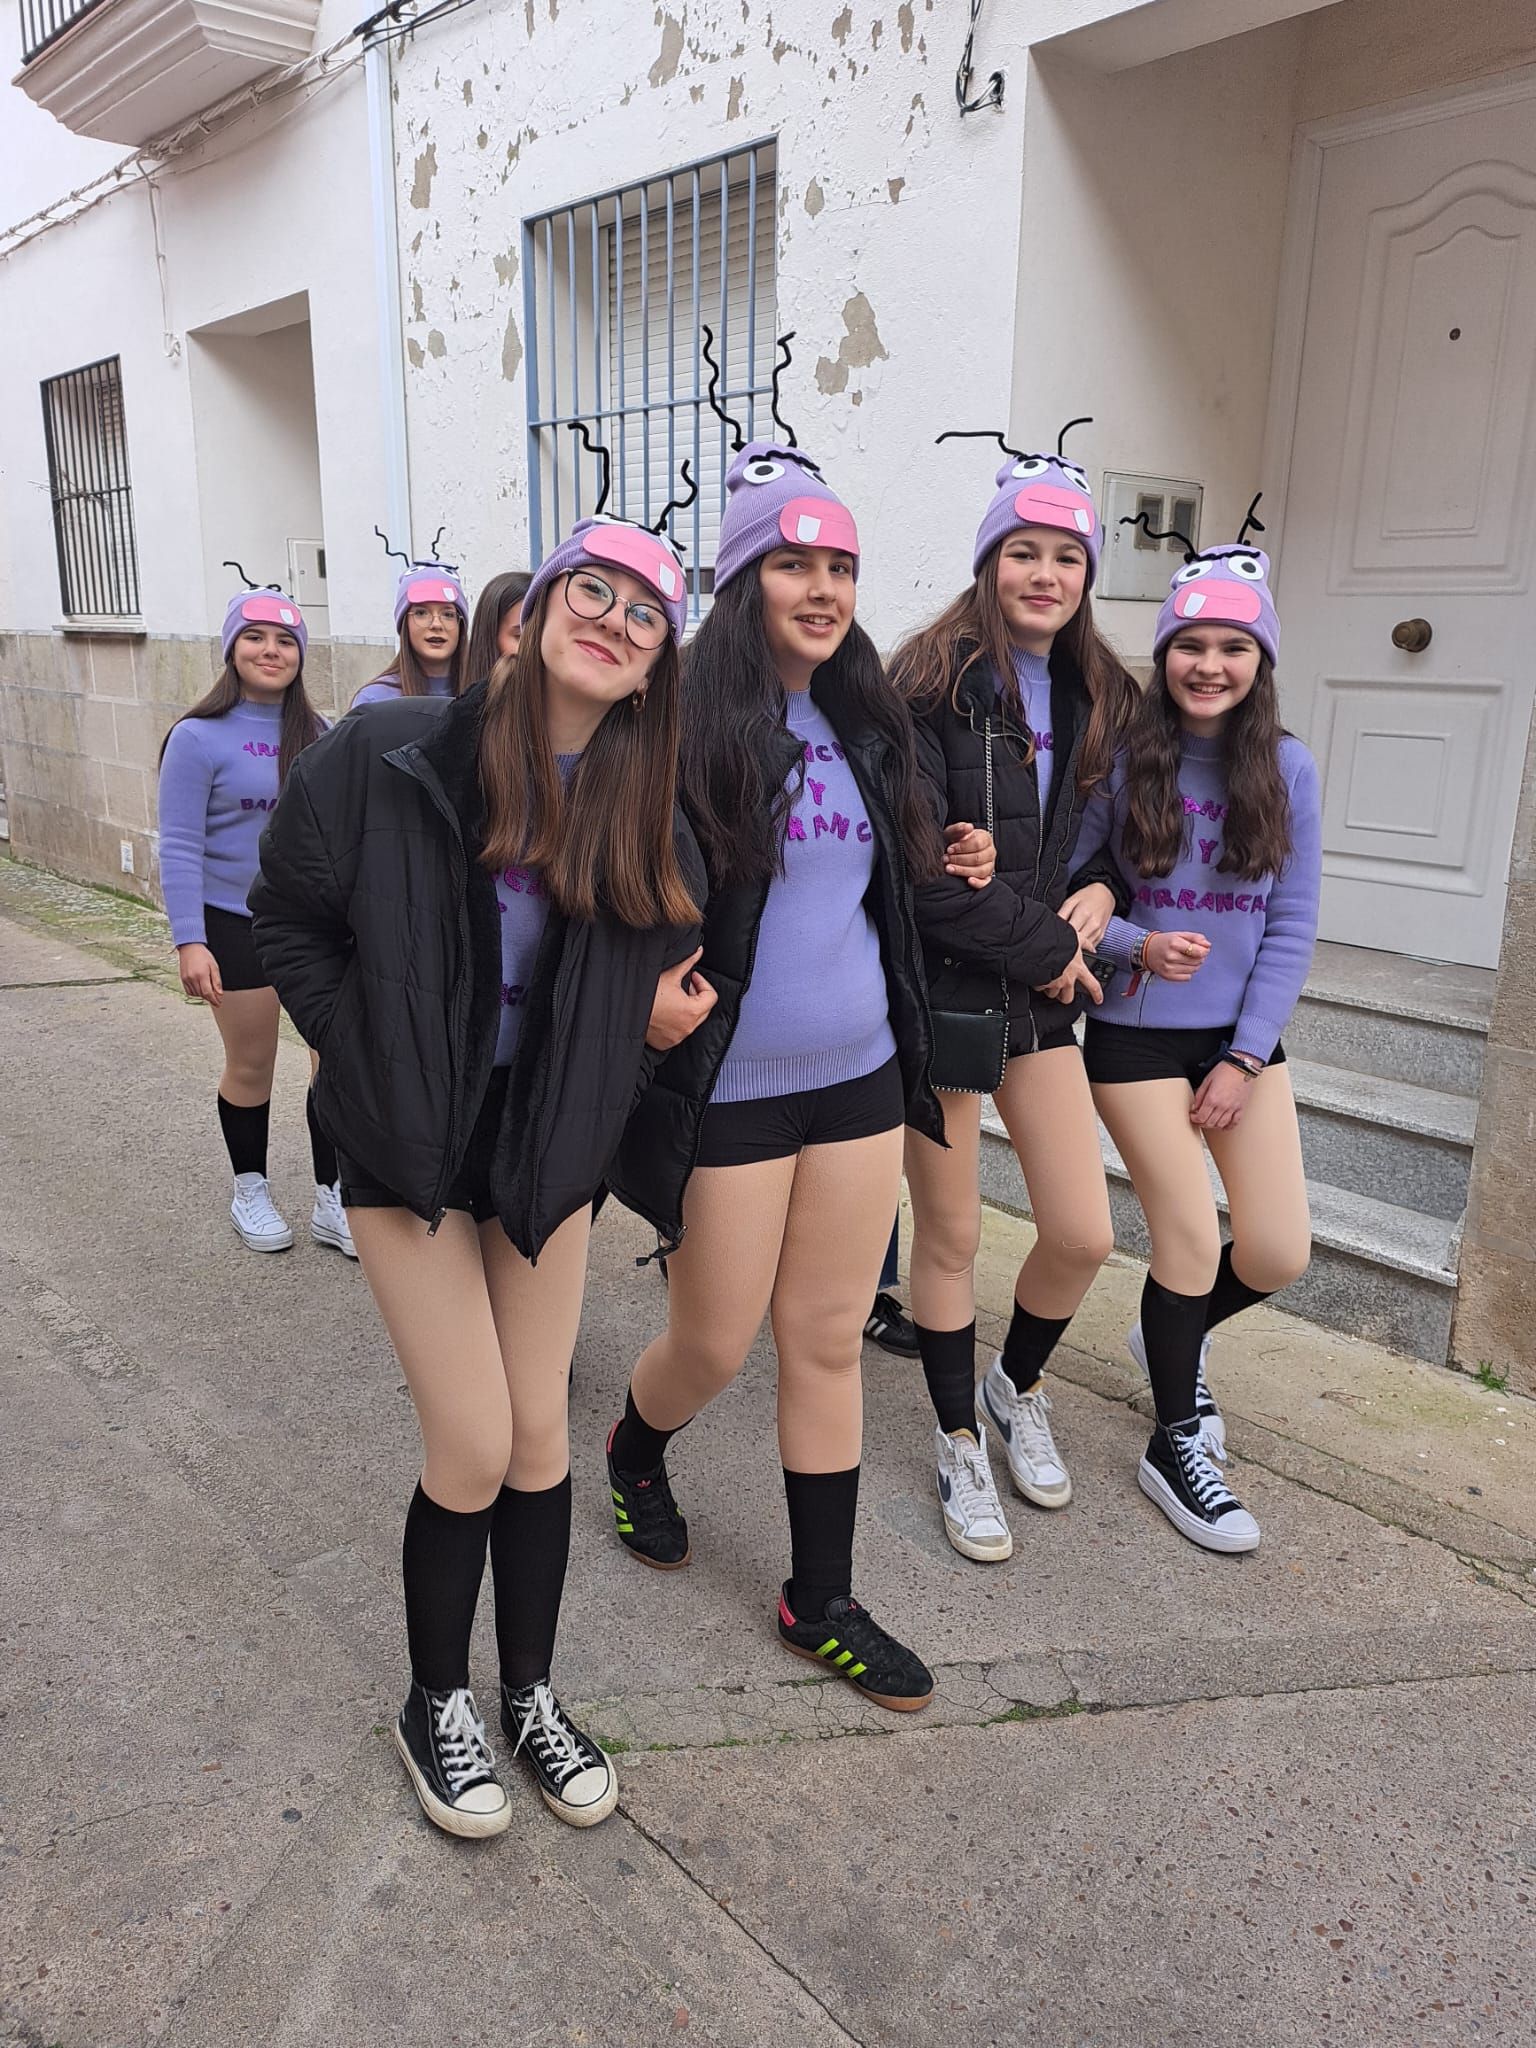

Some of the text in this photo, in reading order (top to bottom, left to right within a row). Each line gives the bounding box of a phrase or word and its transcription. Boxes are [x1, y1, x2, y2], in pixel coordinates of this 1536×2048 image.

[807, 777, 826, 806] Y
[1199, 838, 1218, 864] Y
[1130, 885, 1267, 913] ARRANCA
